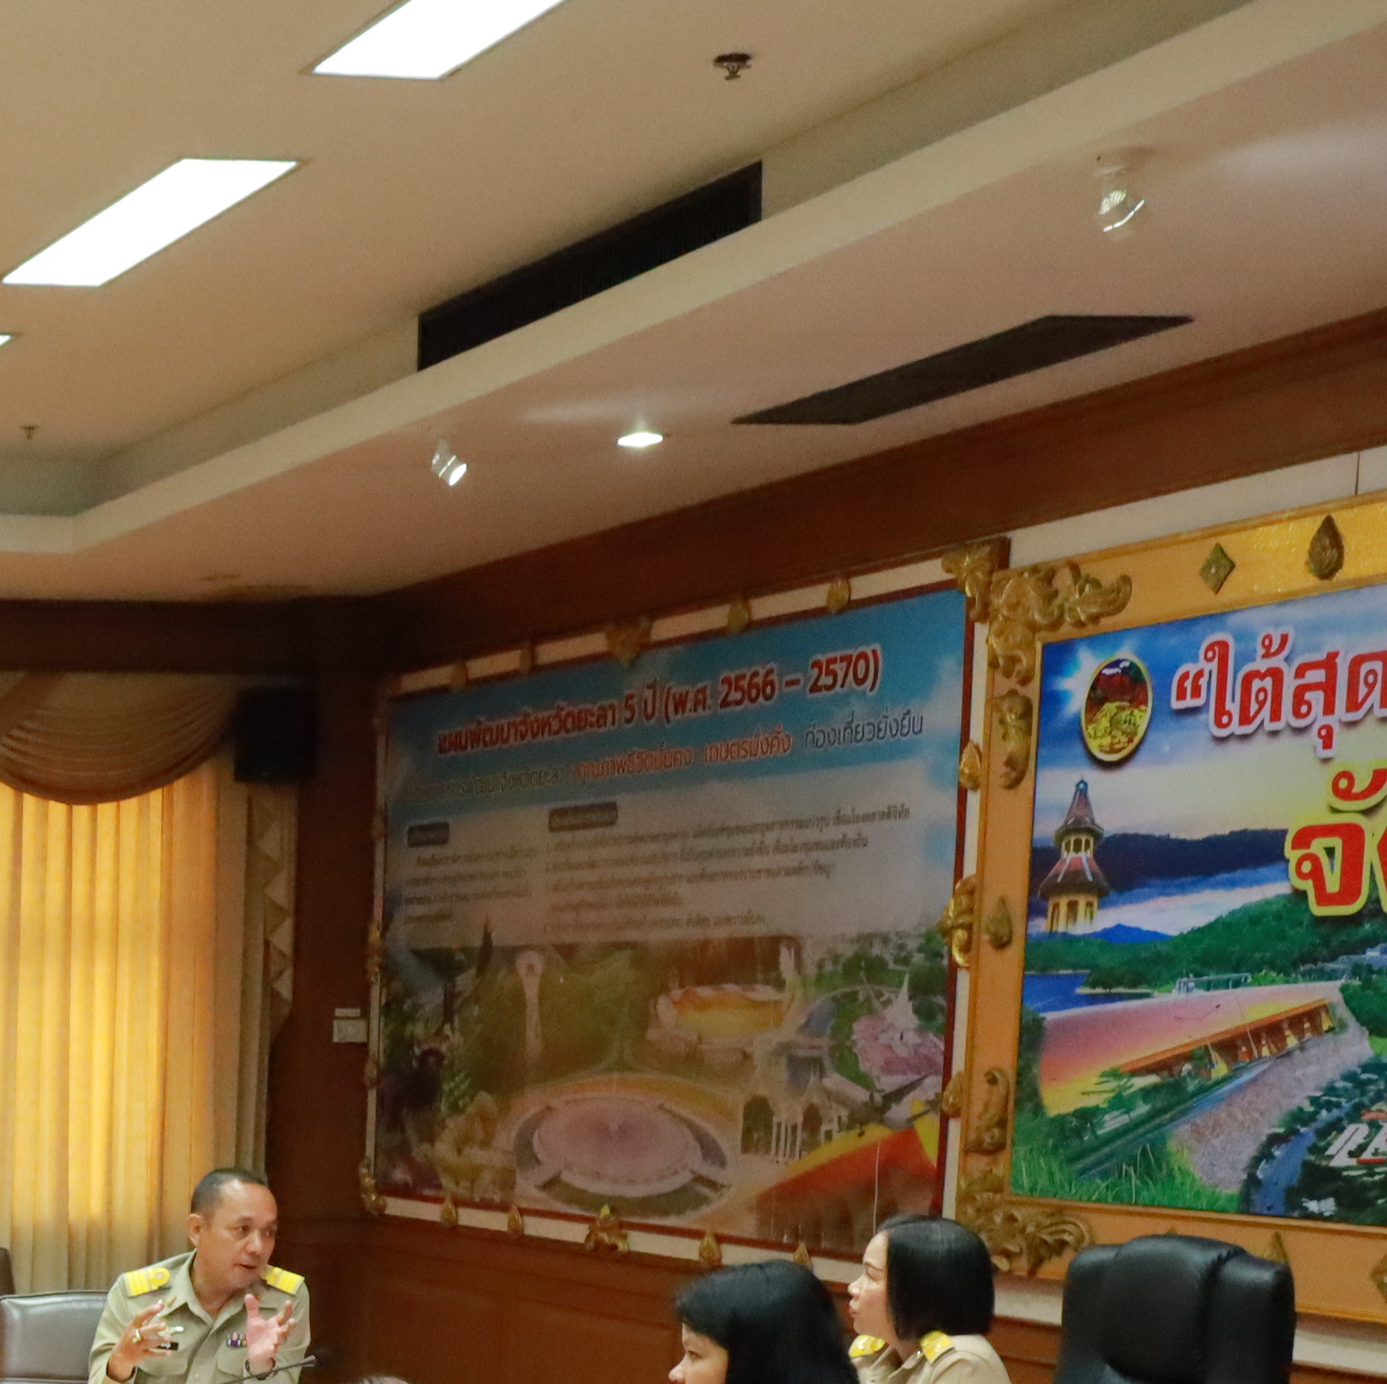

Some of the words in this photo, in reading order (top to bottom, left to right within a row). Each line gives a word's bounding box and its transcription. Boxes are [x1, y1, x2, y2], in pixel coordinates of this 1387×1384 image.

[436, 702, 617, 757] แผนพัฒนาจังหวัดยะลา
[623, 691, 637, 725] 5
[642, 678, 659, 721] ปี
[719, 667, 776, 710] 2566
[808, 650, 881, 694] 2570)
[805, 707, 924, 749] ท่องเที่ยวยั่งยืน
[1290, 768, 1387, 908] จั
